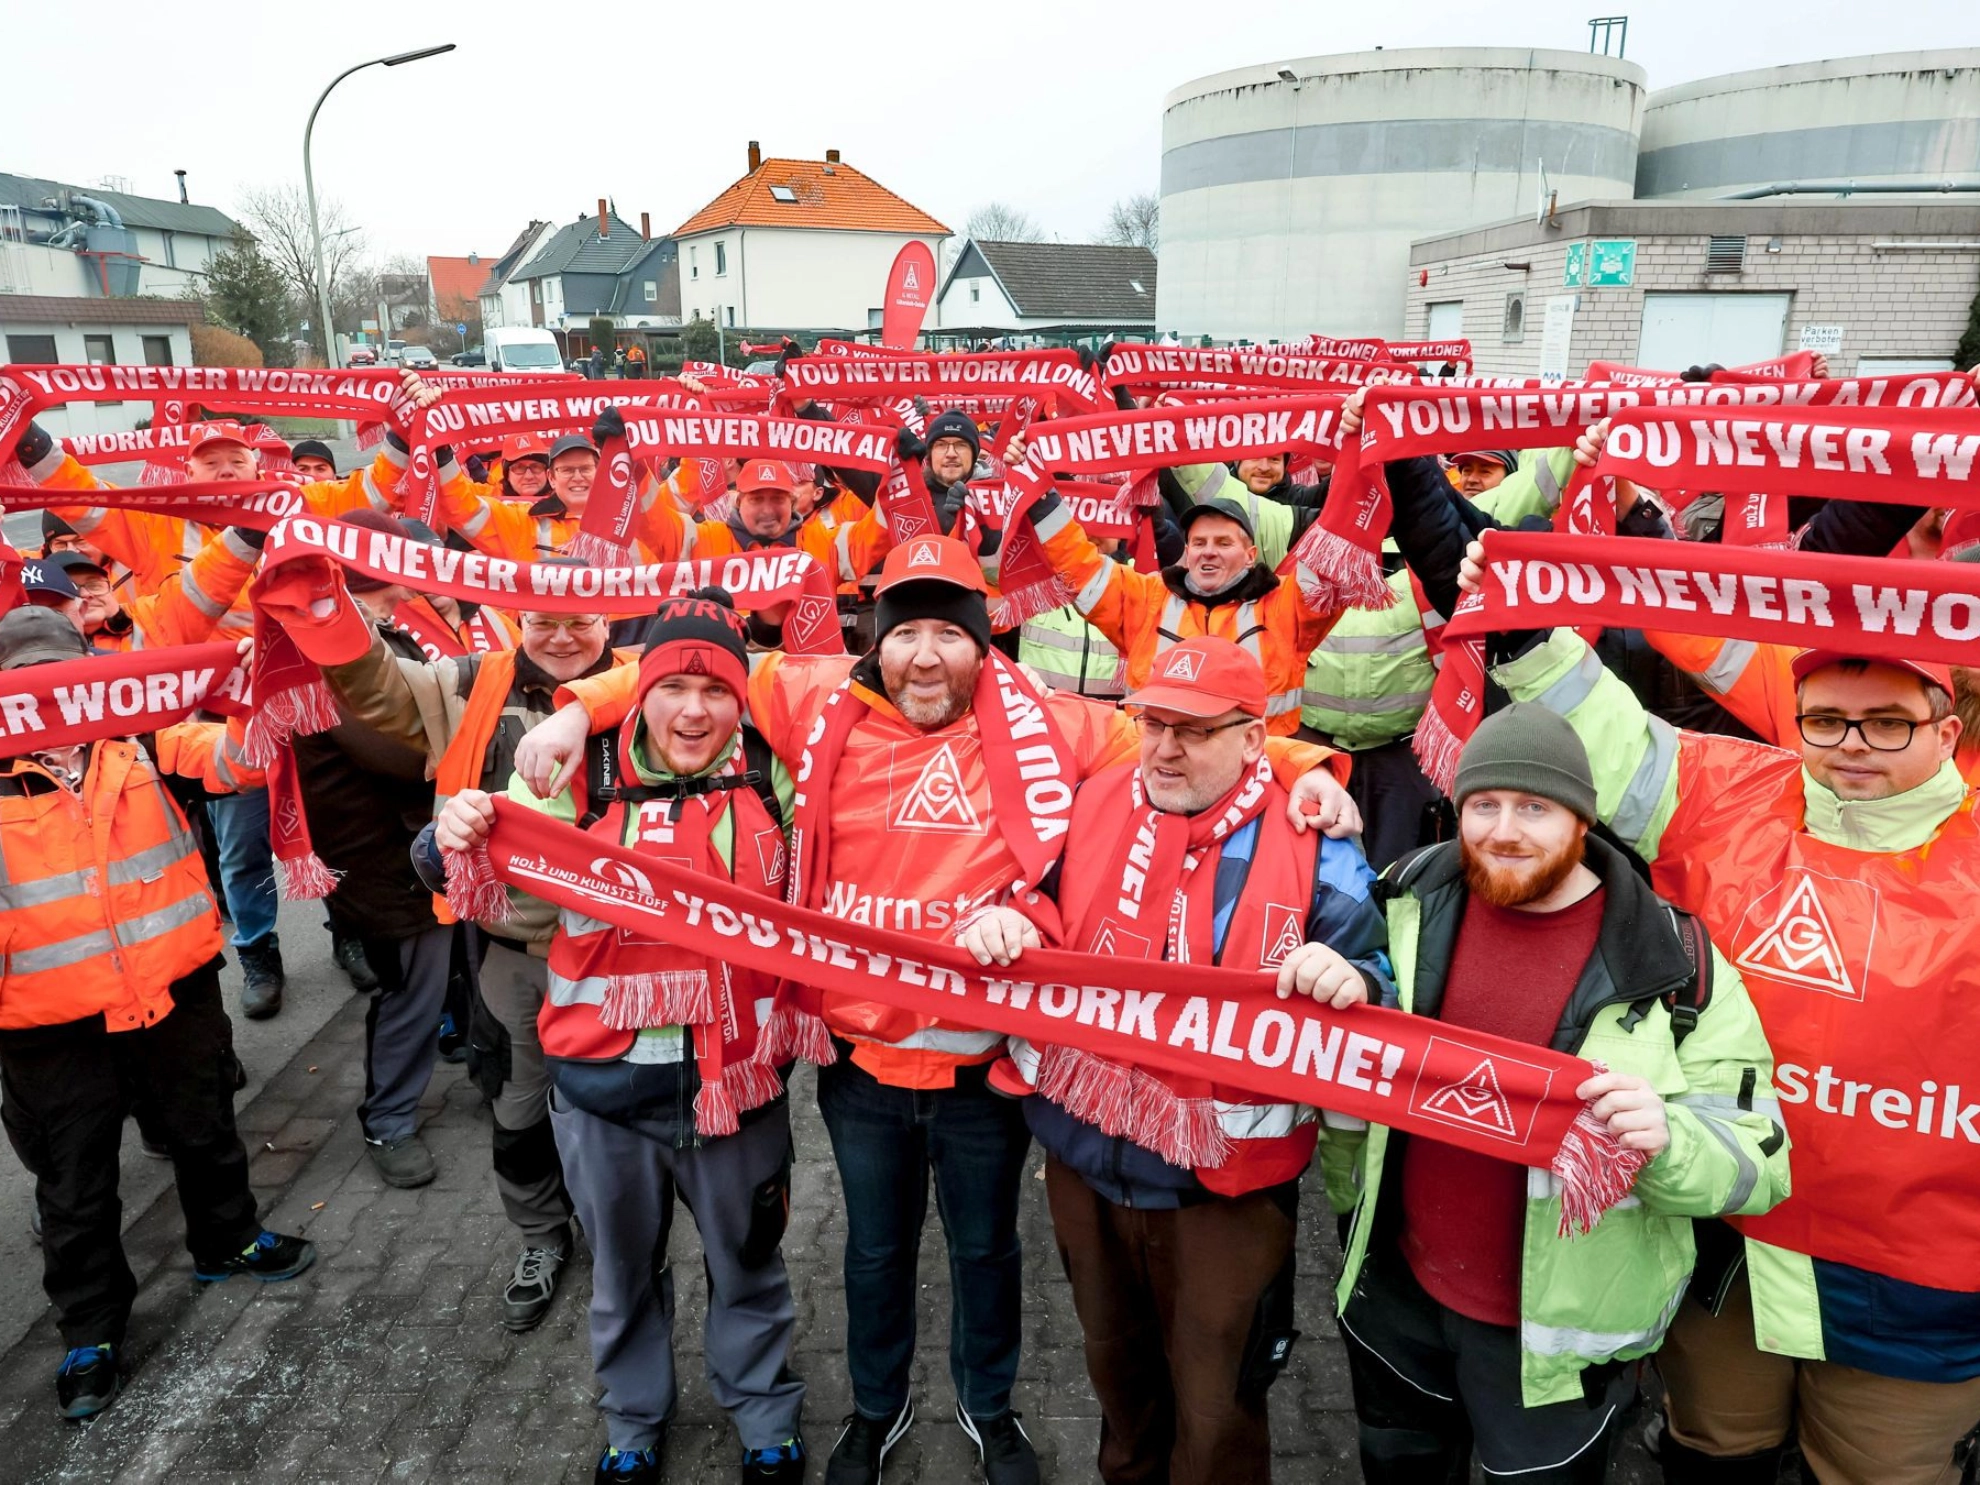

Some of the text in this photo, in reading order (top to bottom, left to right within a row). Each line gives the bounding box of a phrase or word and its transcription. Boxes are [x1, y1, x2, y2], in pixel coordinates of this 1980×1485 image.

[1420, 344, 1464, 357] ALONE!
[1805, 326, 1839, 335] Parken
[1104, 351, 1143, 377] OU
[1144, 350, 1234, 374] NEVER
[1240, 354, 1327, 381] WORK
[1314, 340, 1379, 363] ALONE!
[22, 367, 107, 394] YOU
[110, 367, 228, 391] NEVER
[236, 368, 336, 395] WORK
[785, 362, 840, 388] YOU
[843, 361, 931, 383] NEVER
[937, 360, 1021, 383] WORK
[425, 403, 466, 439] OU
[464, 398, 561, 427] NEVER
[929, 399, 980, 415] EVER
[1377, 396, 1472, 439] YOU
[1480, 390, 1641, 431] NEVER
[70, 433, 154, 456] WORK
[625, 418, 660, 449] OU
[664, 418, 760, 447] NEVER
[767, 421, 856, 454] WORK
[1011, 436, 1063, 484] YOU
[1066, 419, 1179, 463] NEVER
[1184, 410, 1292, 451] WORK
[1606, 421, 1682, 467] OU
[1690, 419, 1892, 475] NEVER
[621, 498, 632, 517] UND
[1355, 503, 1372, 528] HOLZ
[268, 517, 813, 598] YOU NEVER WORK ALONE!
[663, 600, 747, 639] NRW
[1490, 560, 1980, 641] YOU NEVER WO
[53, 668, 216, 726] WORK
[602, 738, 611, 786] DAKINE
[1015, 744, 1073, 843] YOU
[509, 854, 670, 910] HOLZ UND KUNSTSTOFF
[673, 890, 1406, 1097] YOU NEVER WORK ALONE!
[1774, 1062, 1980, 1143] streik
